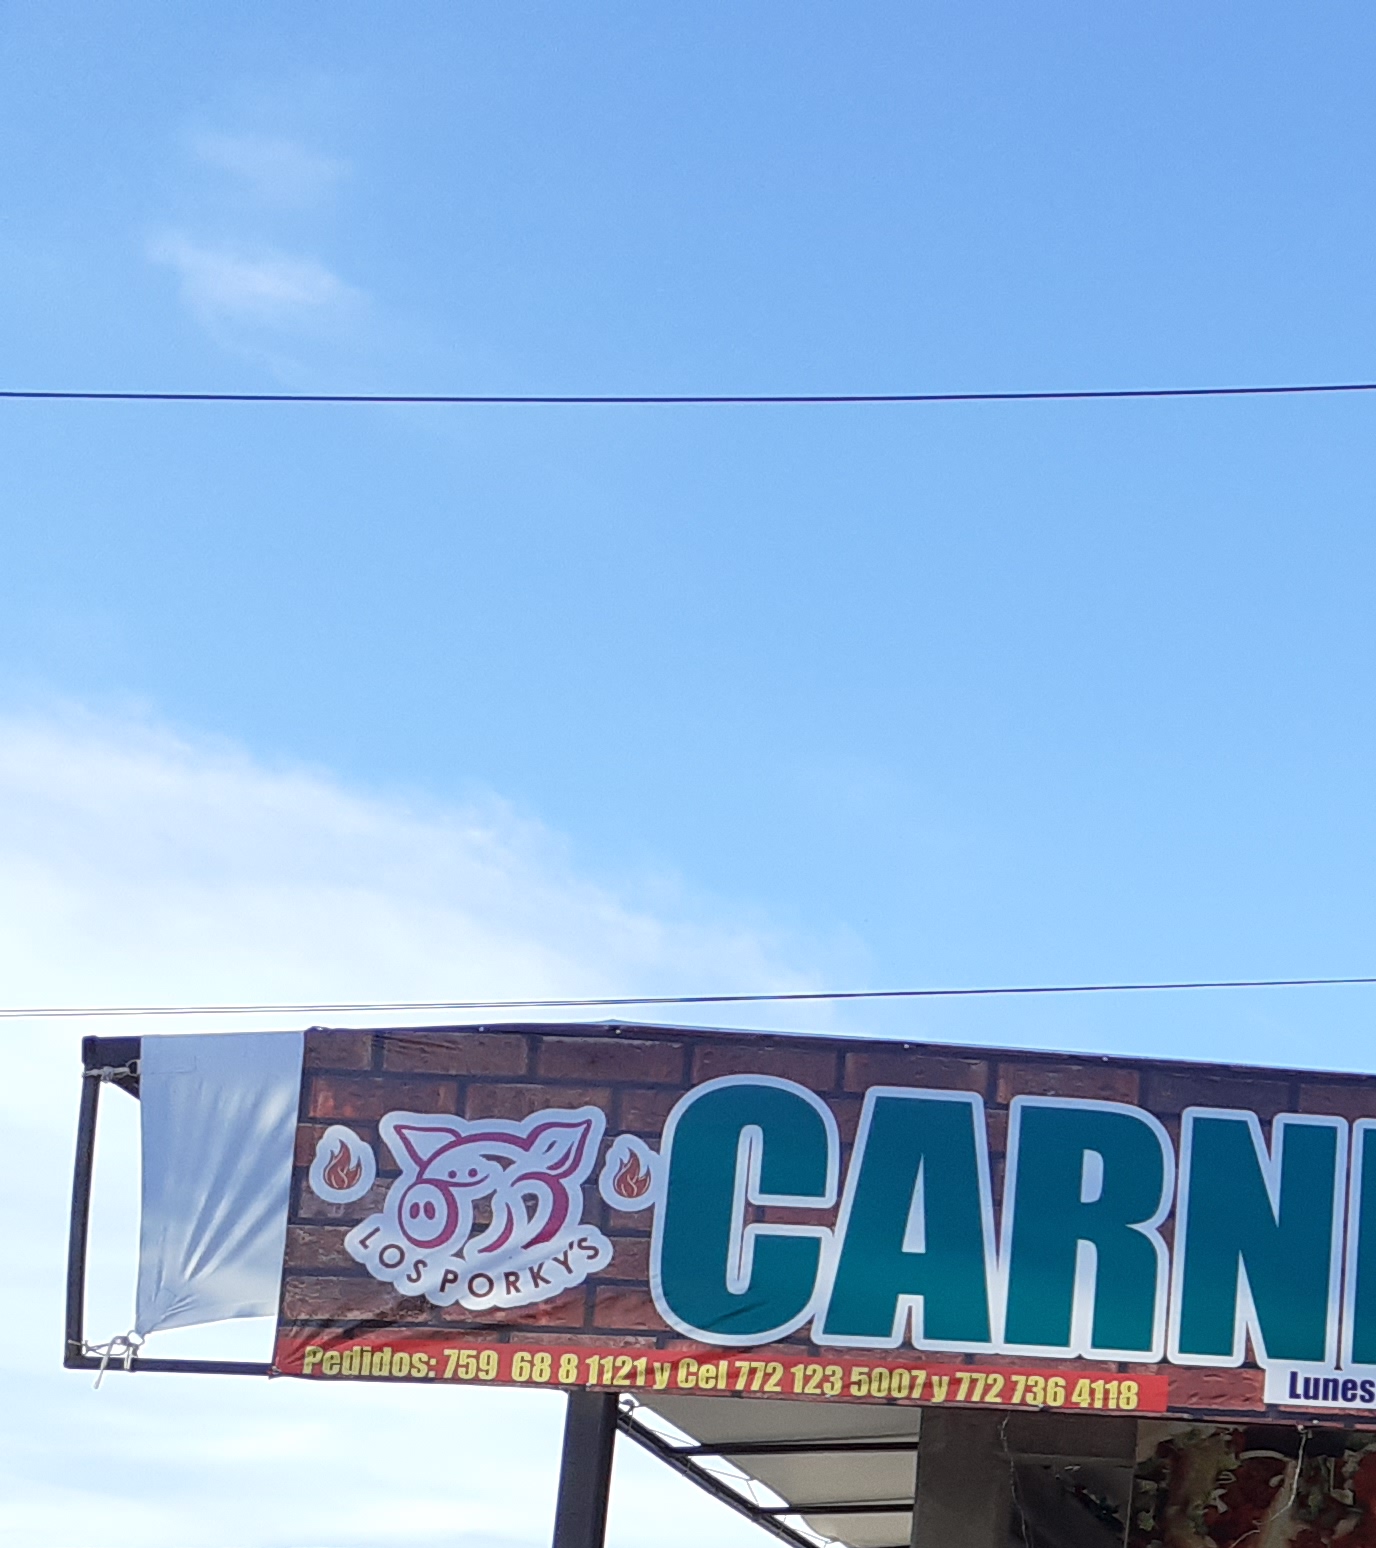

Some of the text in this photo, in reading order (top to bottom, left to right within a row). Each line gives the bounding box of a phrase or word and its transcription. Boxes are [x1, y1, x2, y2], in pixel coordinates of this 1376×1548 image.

[359, 1226, 600, 1298] LOS PORKY'S
[302, 1345, 1138, 1410] Pedidos: 759 68 8 1121 y Cel 772 123 5007 y 772 736 4118
[1289, 1371, 1375, 1404] Lunes
